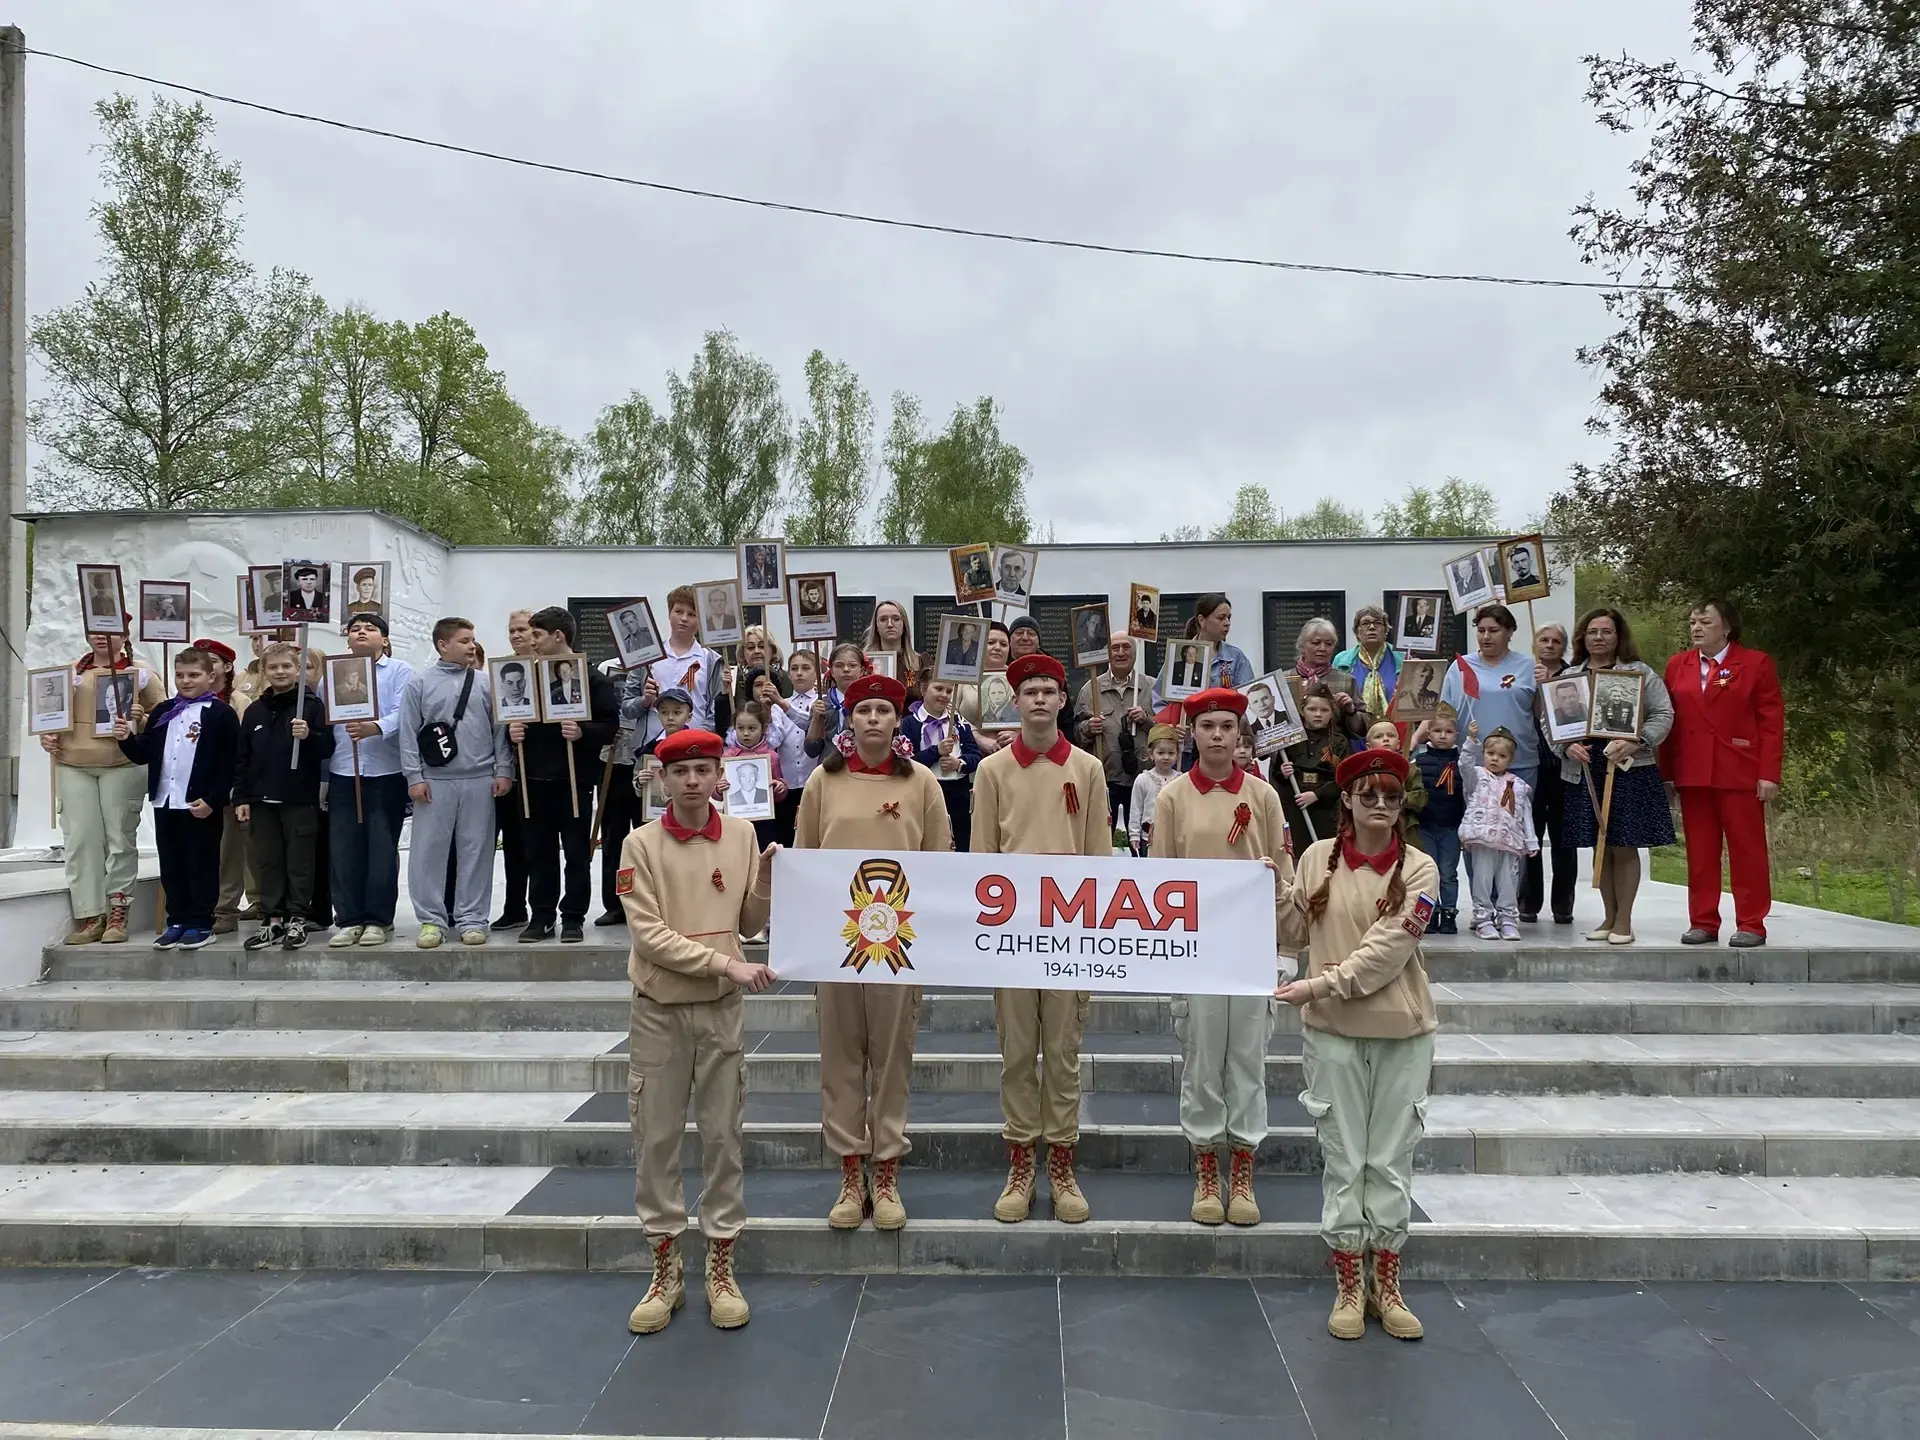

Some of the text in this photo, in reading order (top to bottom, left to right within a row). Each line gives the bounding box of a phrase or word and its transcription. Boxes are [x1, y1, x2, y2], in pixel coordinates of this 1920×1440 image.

[433, 726, 452, 758] FILA
[975, 874, 1199, 933] 9 МАЯ
[975, 933, 1198, 961] С ДНЕМ ПОБЕДЫ!
[1043, 962, 1127, 979] 1941-1945
